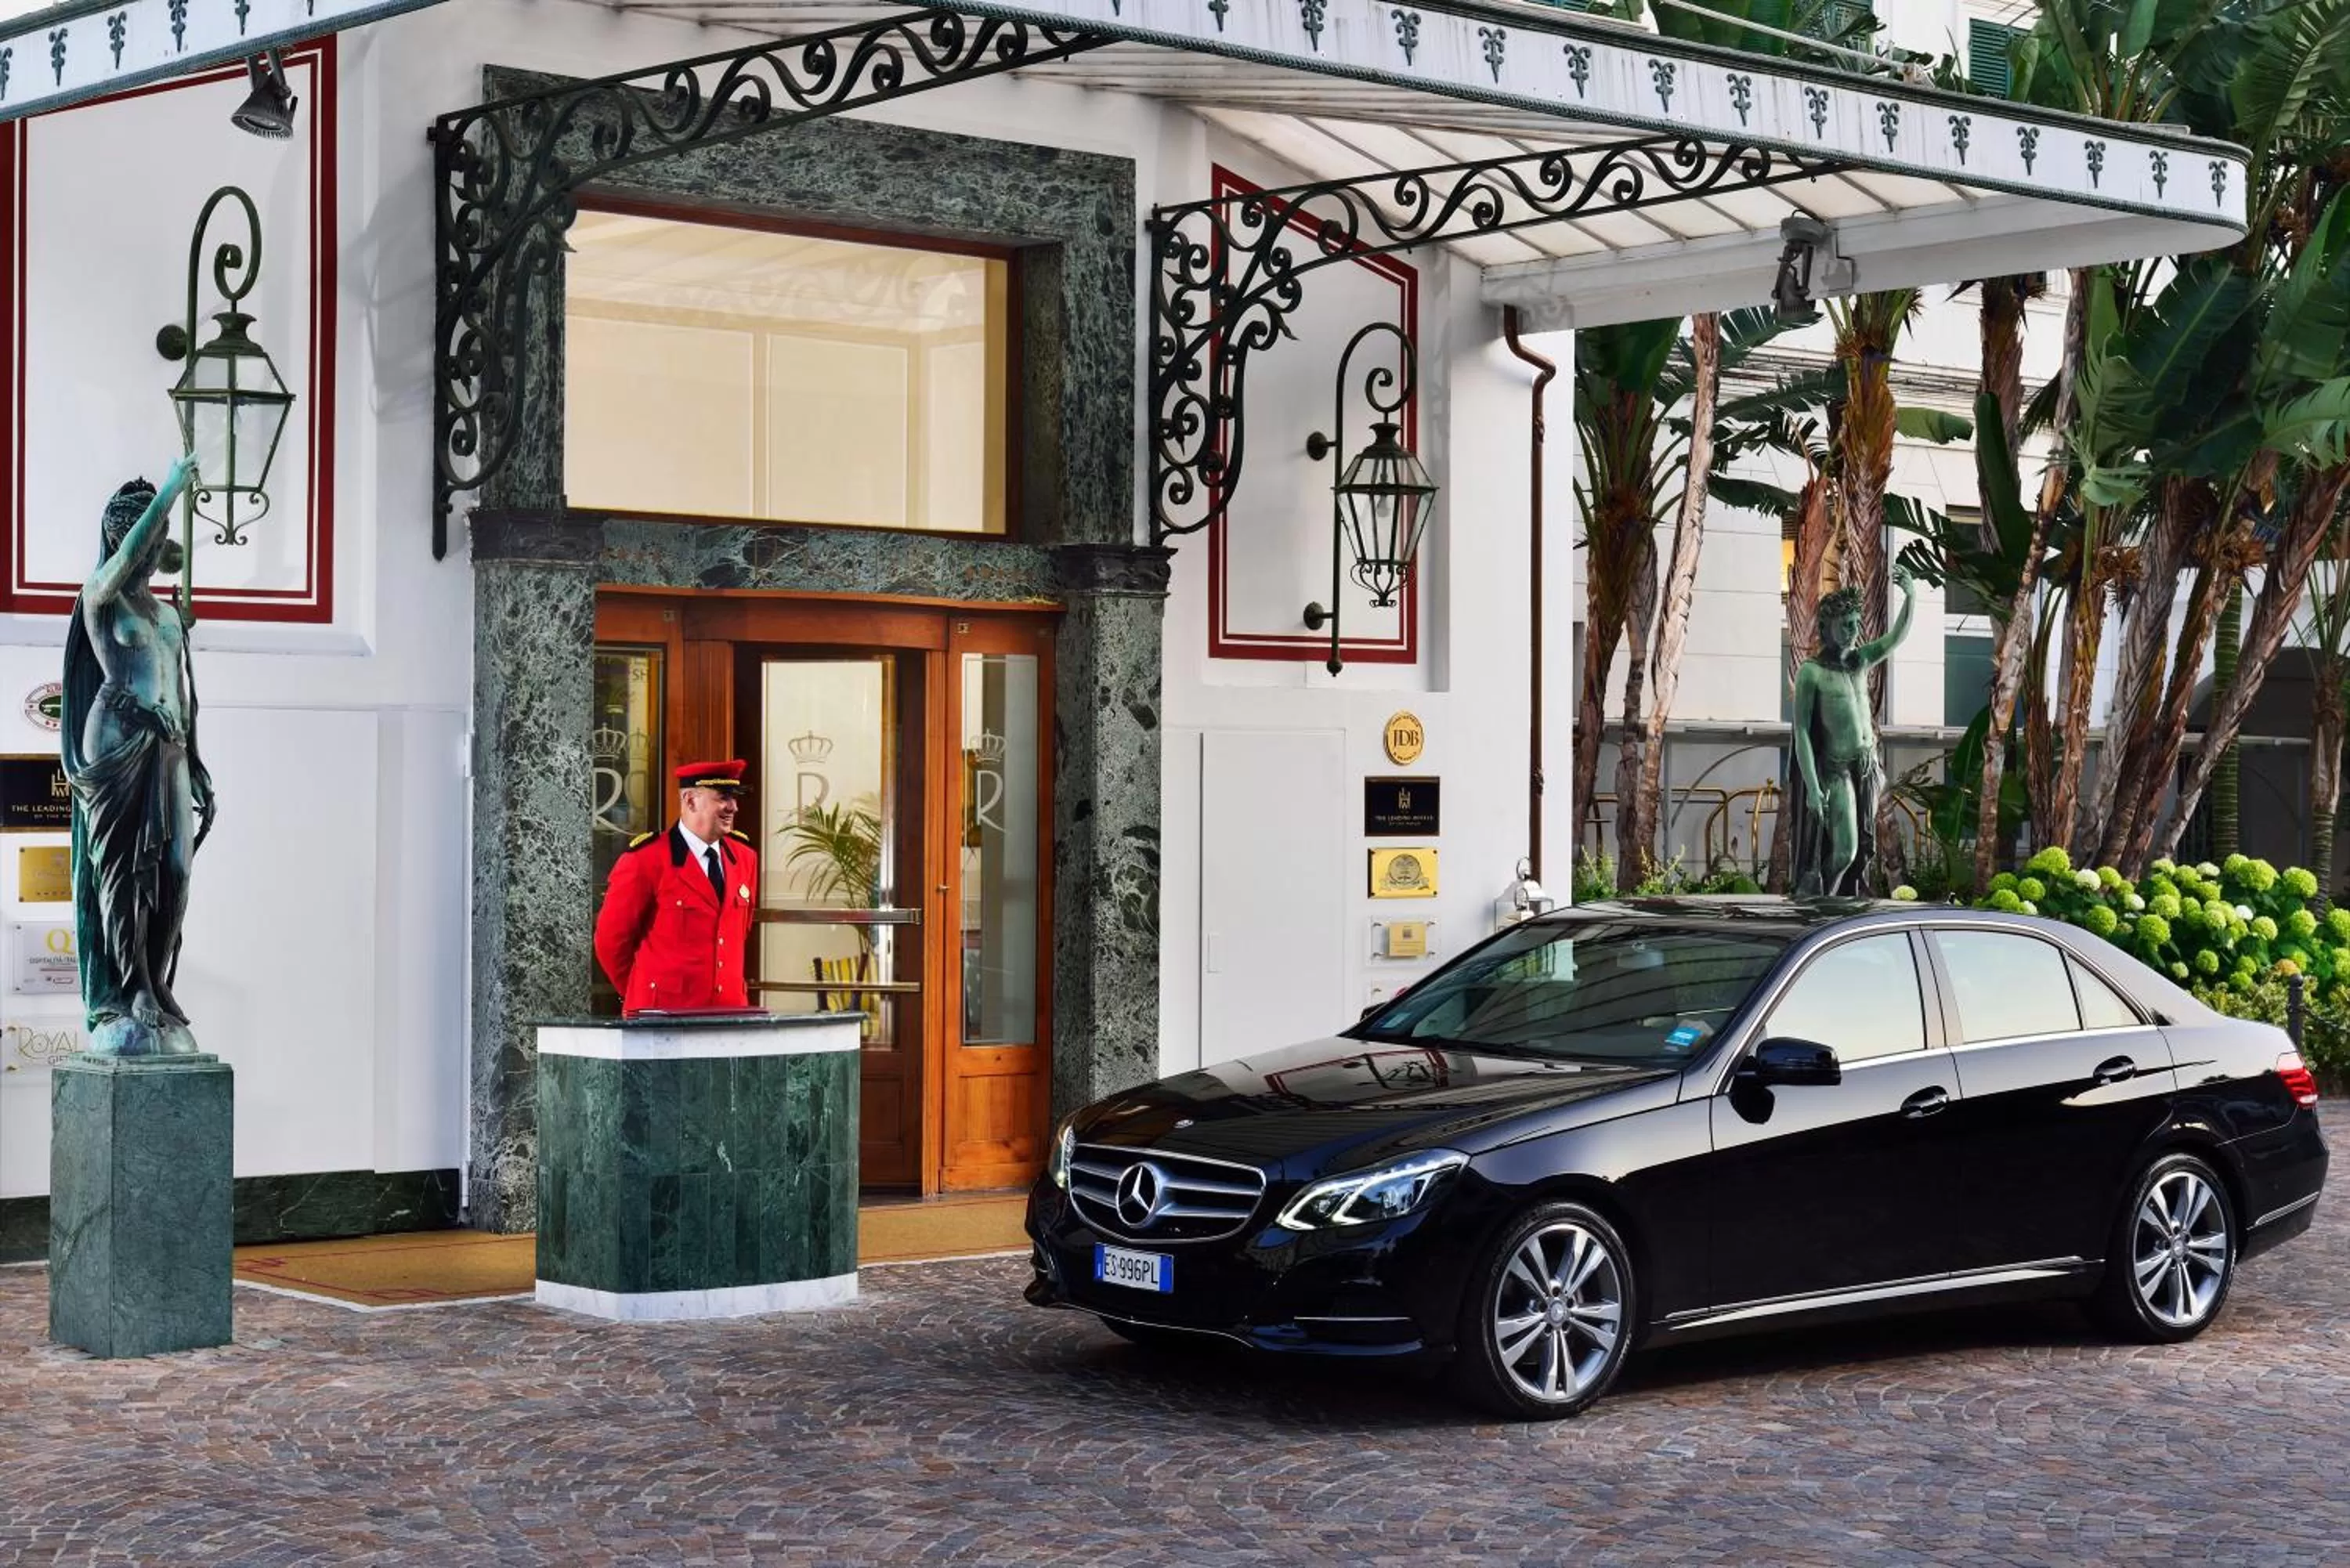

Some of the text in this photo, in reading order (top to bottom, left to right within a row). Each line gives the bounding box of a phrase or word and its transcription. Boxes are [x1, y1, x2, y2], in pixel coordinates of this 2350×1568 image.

[1393, 729, 1419, 747] JDB
[977, 770, 1011, 835] R
[47, 927, 74, 955] Q
